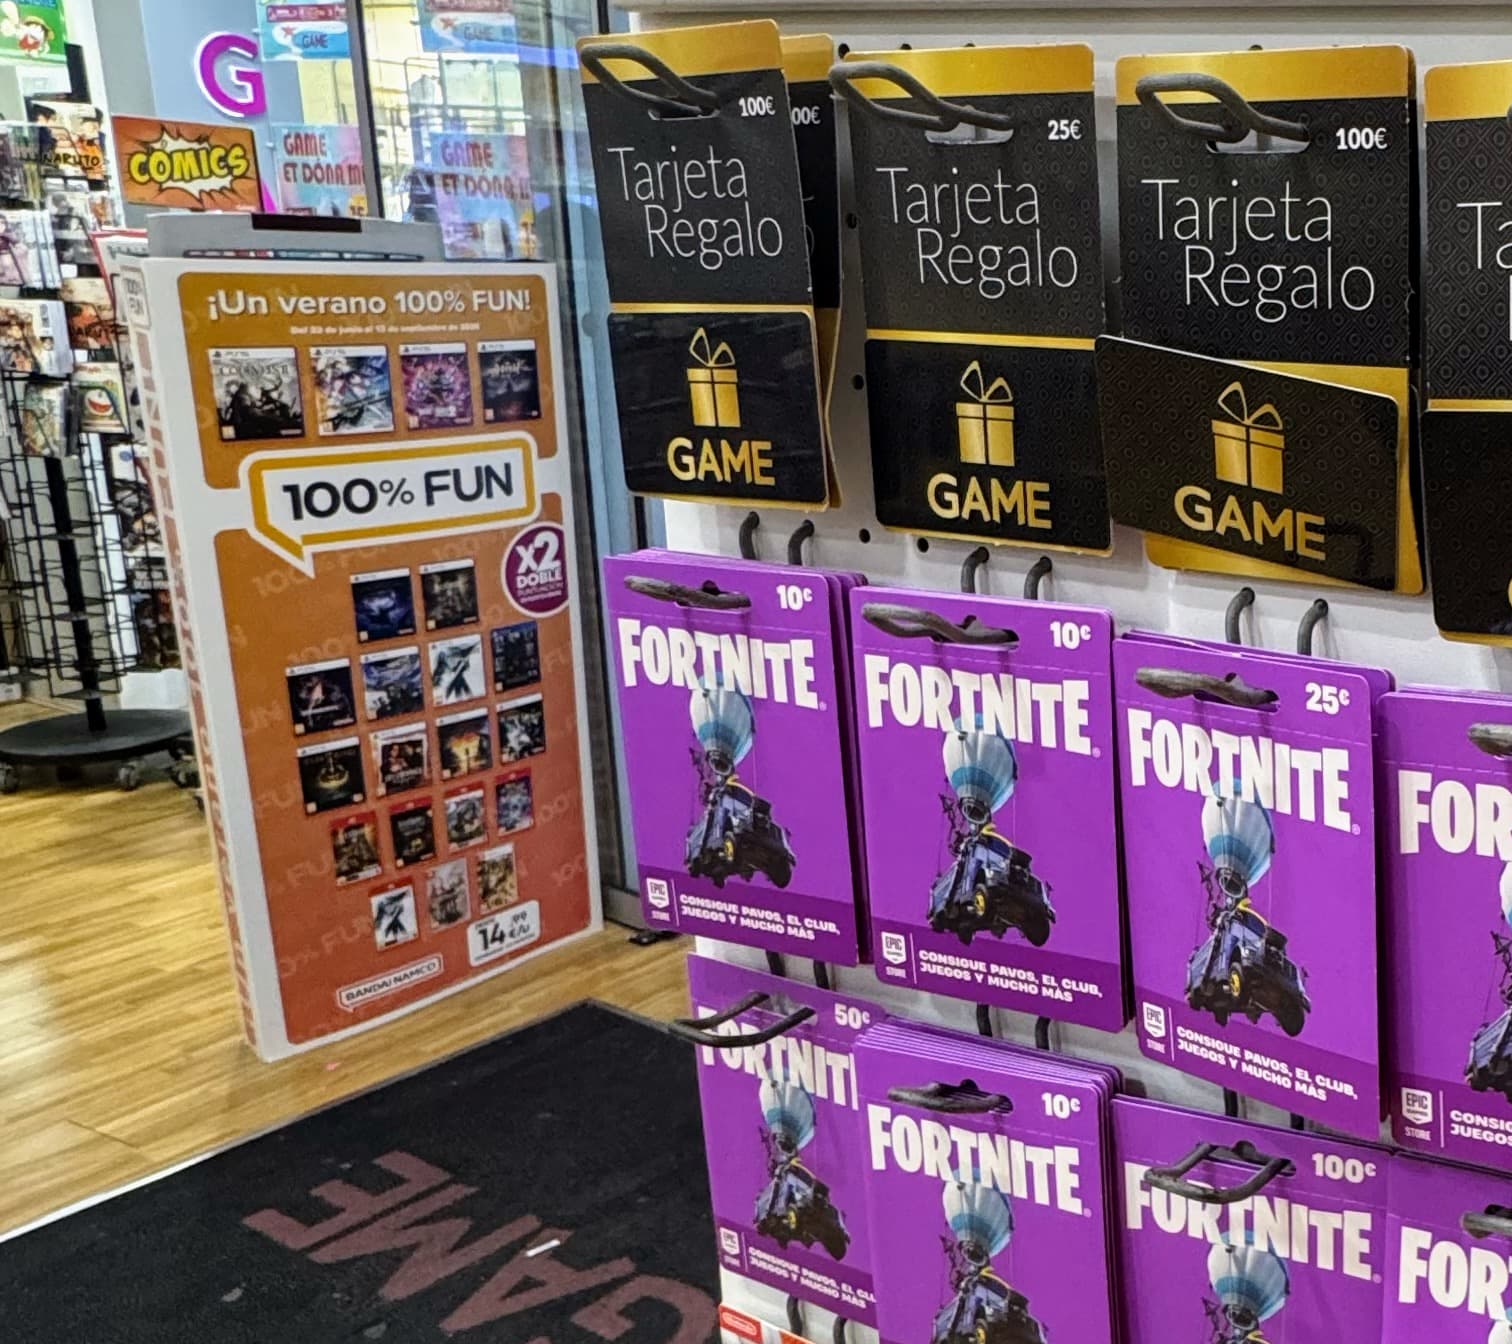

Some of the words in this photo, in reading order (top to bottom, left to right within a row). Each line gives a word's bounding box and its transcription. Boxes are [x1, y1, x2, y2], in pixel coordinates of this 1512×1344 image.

[738, 96, 775, 117] 100€
[1048, 121, 1082, 141] 25€
[1336, 128, 1387, 150] 100€
[129, 144, 249, 185] COMICS
[608, 146, 747, 212] Tarjeta
[645, 201, 782, 270] Regalo
[876, 167, 1039, 237] Tarjeta
[1141, 179, 1332, 255] Tarjeta
[918, 228, 1077, 298] Regalo
[1184, 246, 1375, 323] Regalo
[208, 289, 268, 321] ¡Un
[281, 296, 386, 315] verano
[397, 291, 465, 313] 100%
[473, 290, 530, 313] FUN!
[282, 476, 415, 521] 100%
[423, 463, 513, 507] FUN
[667, 437, 775, 485] GAME
[927, 473, 1052, 528] GAME
[1174, 485, 1326, 560] GAME
[618, 618, 818, 711] FORTNITE
[863, 654, 1092, 757] FORTNITE
[1127, 708, 1351, 833] FORTNITE
[697, 1006, 859, 1110] FORTNIT
[1405, 1092, 1428, 1109] EPIC
[867, 1103, 1082, 1217] FORTNITE
[1124, 1162, 1372, 1282] FORTNITE
